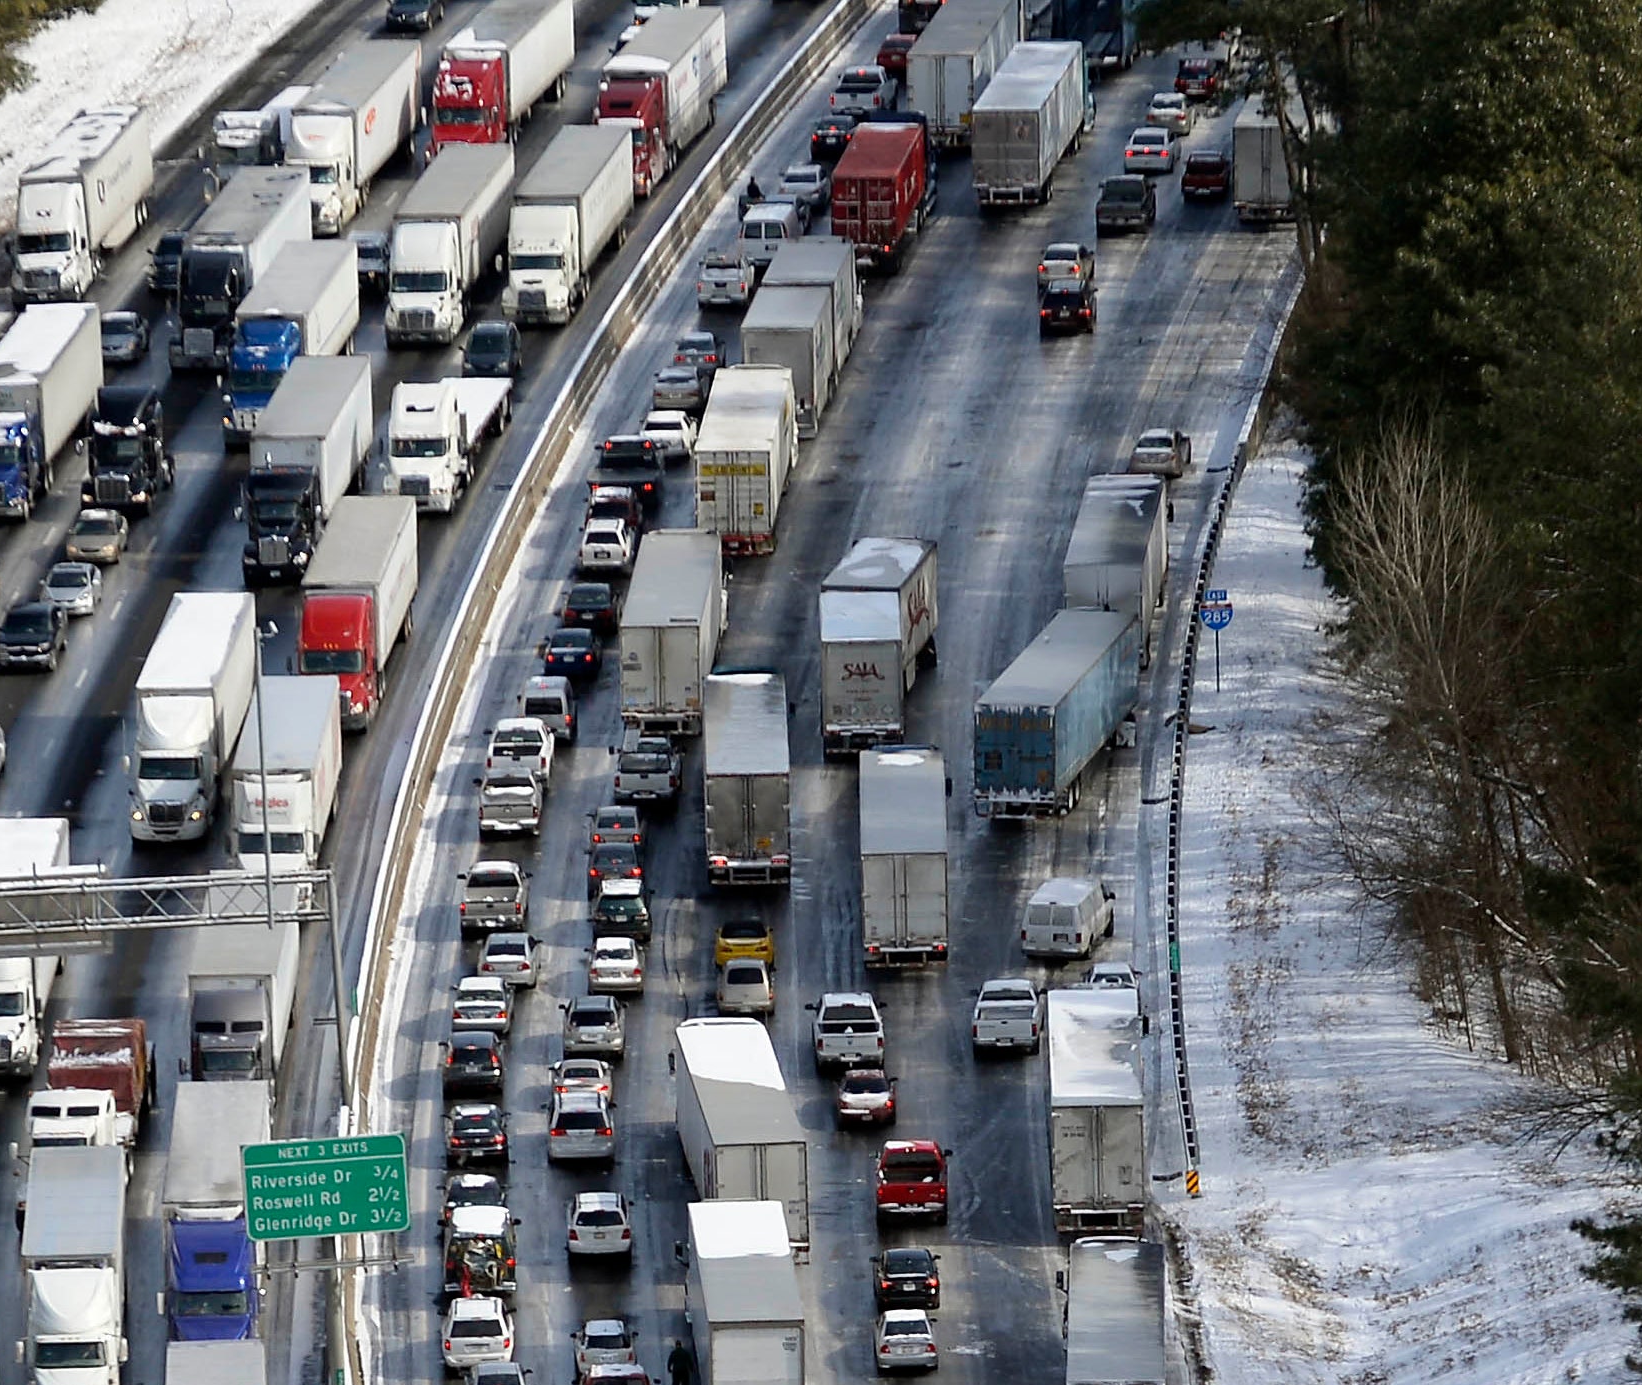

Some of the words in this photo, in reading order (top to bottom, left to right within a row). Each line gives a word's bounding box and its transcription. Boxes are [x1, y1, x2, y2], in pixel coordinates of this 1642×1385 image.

[1204, 610, 1230, 624] 285
[842, 662, 885, 681] SAIA
[279, 1145, 309, 1158] NEXT
[318, 1145, 325, 1156] 3
[333, 1141, 368, 1155] EXITS
[252, 1172, 326, 1189] Riverside
[333, 1169, 352, 1183] Dr
[373, 1165, 398, 1180] 3/4
[253, 1193, 314, 1210] Roswell
[320, 1191, 341, 1205] Rd
[255, 1215, 332, 1232] Glenridge
[339, 1211, 357, 1226] Dr
